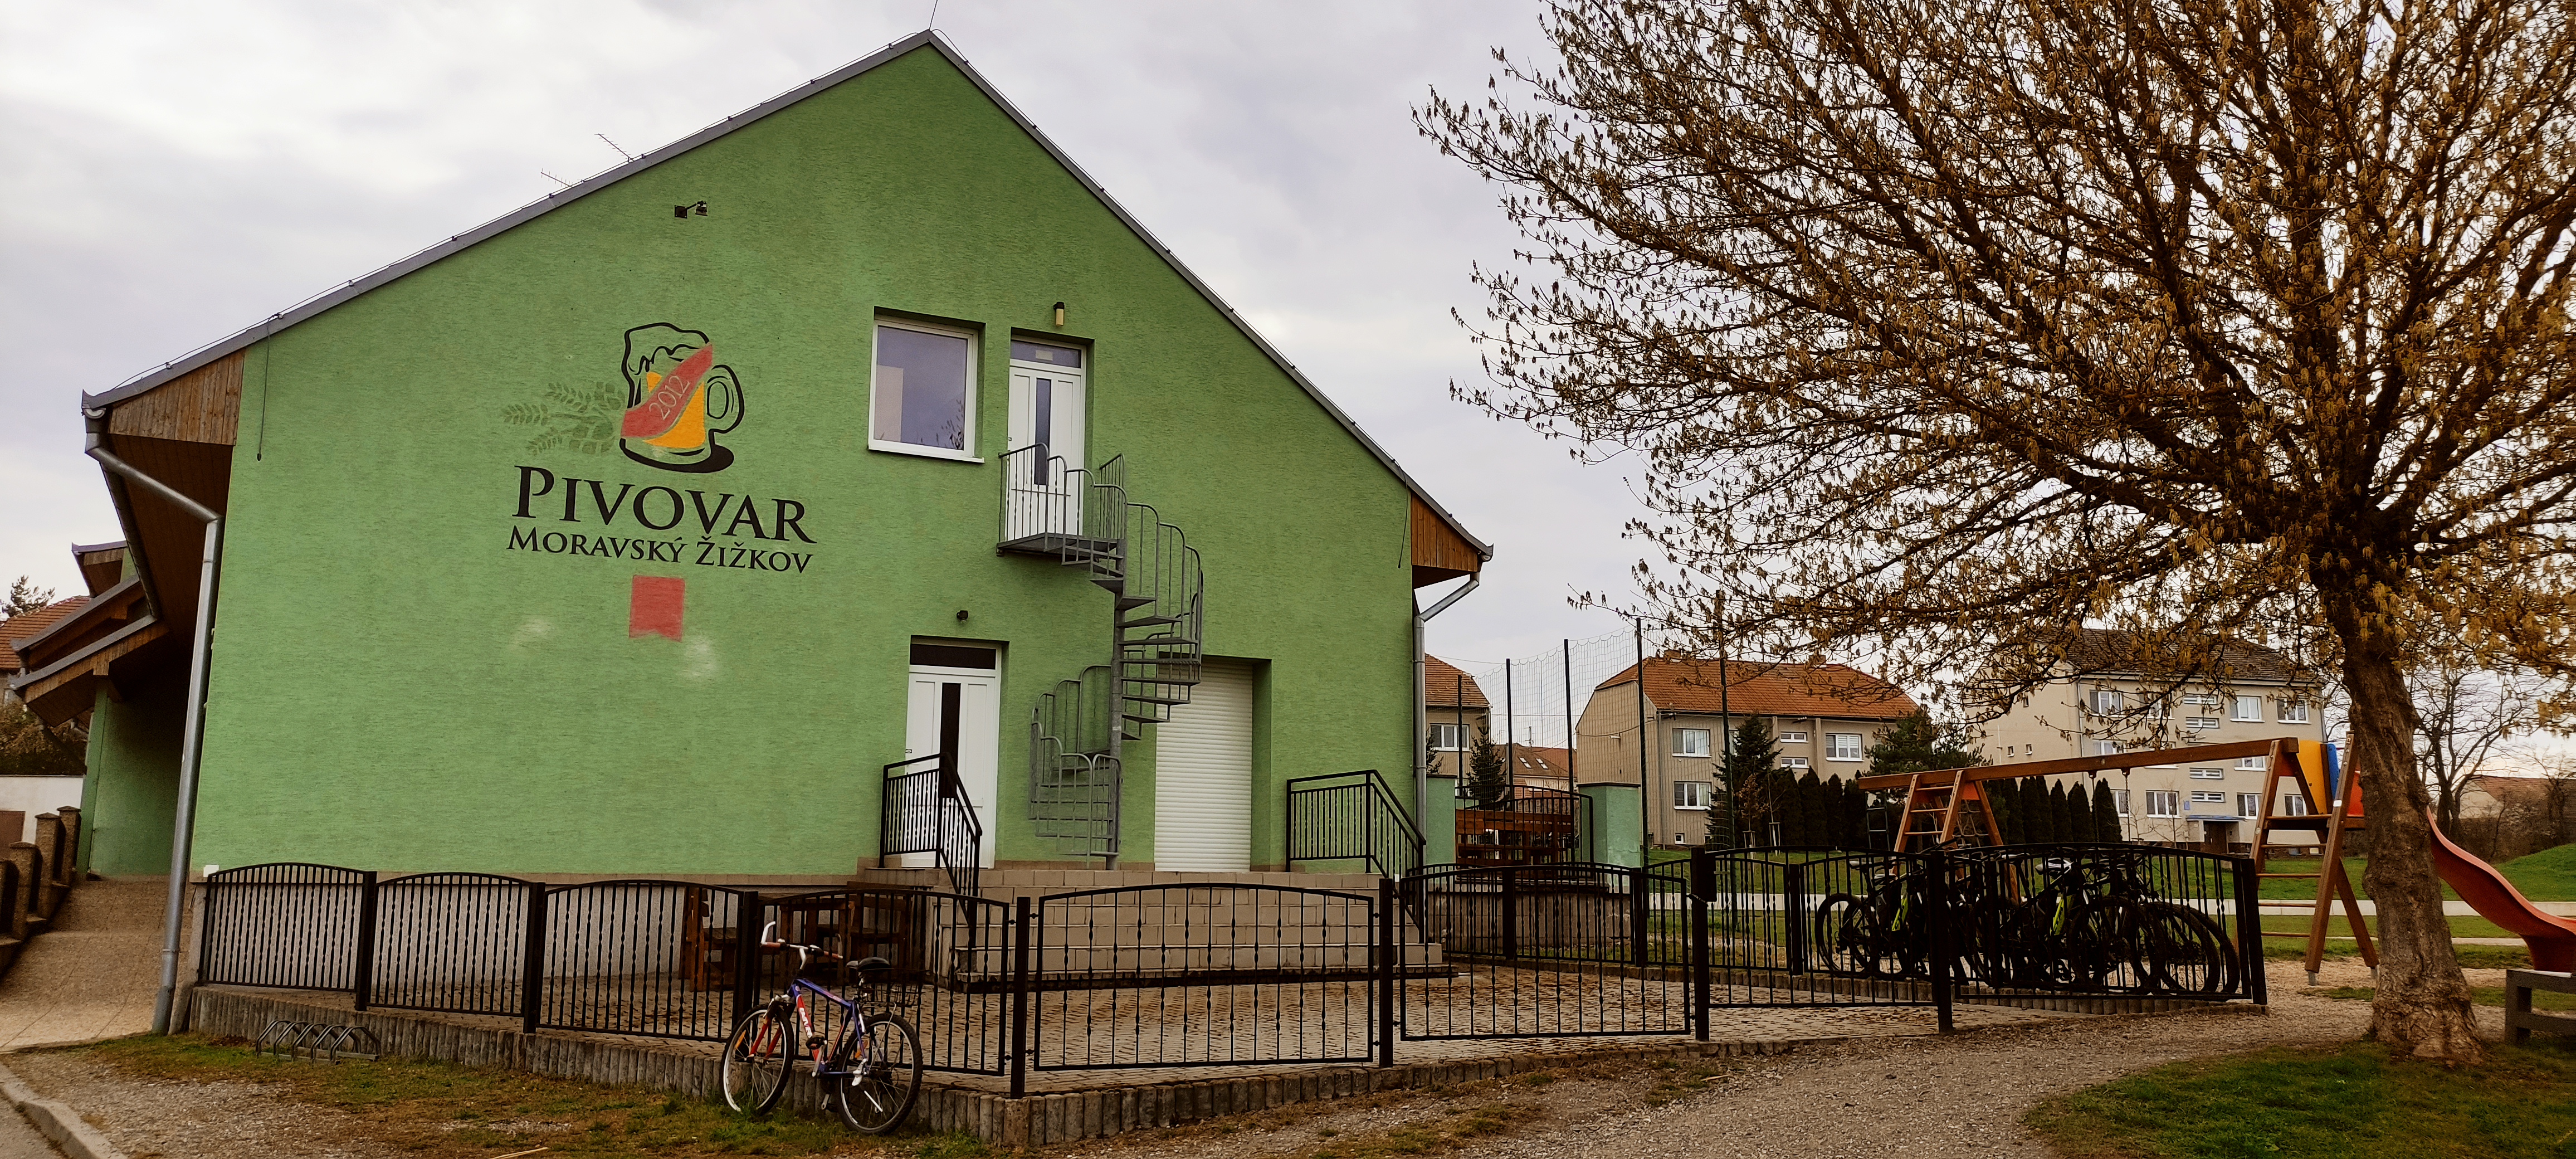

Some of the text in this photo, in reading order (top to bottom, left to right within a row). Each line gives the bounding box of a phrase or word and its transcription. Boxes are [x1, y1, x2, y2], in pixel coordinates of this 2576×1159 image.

[648, 375, 691, 421] 2012
[511, 465, 818, 544] PIVOVAR
[506, 525, 814, 573] MORAVSKÝ ŽIŽKOV
